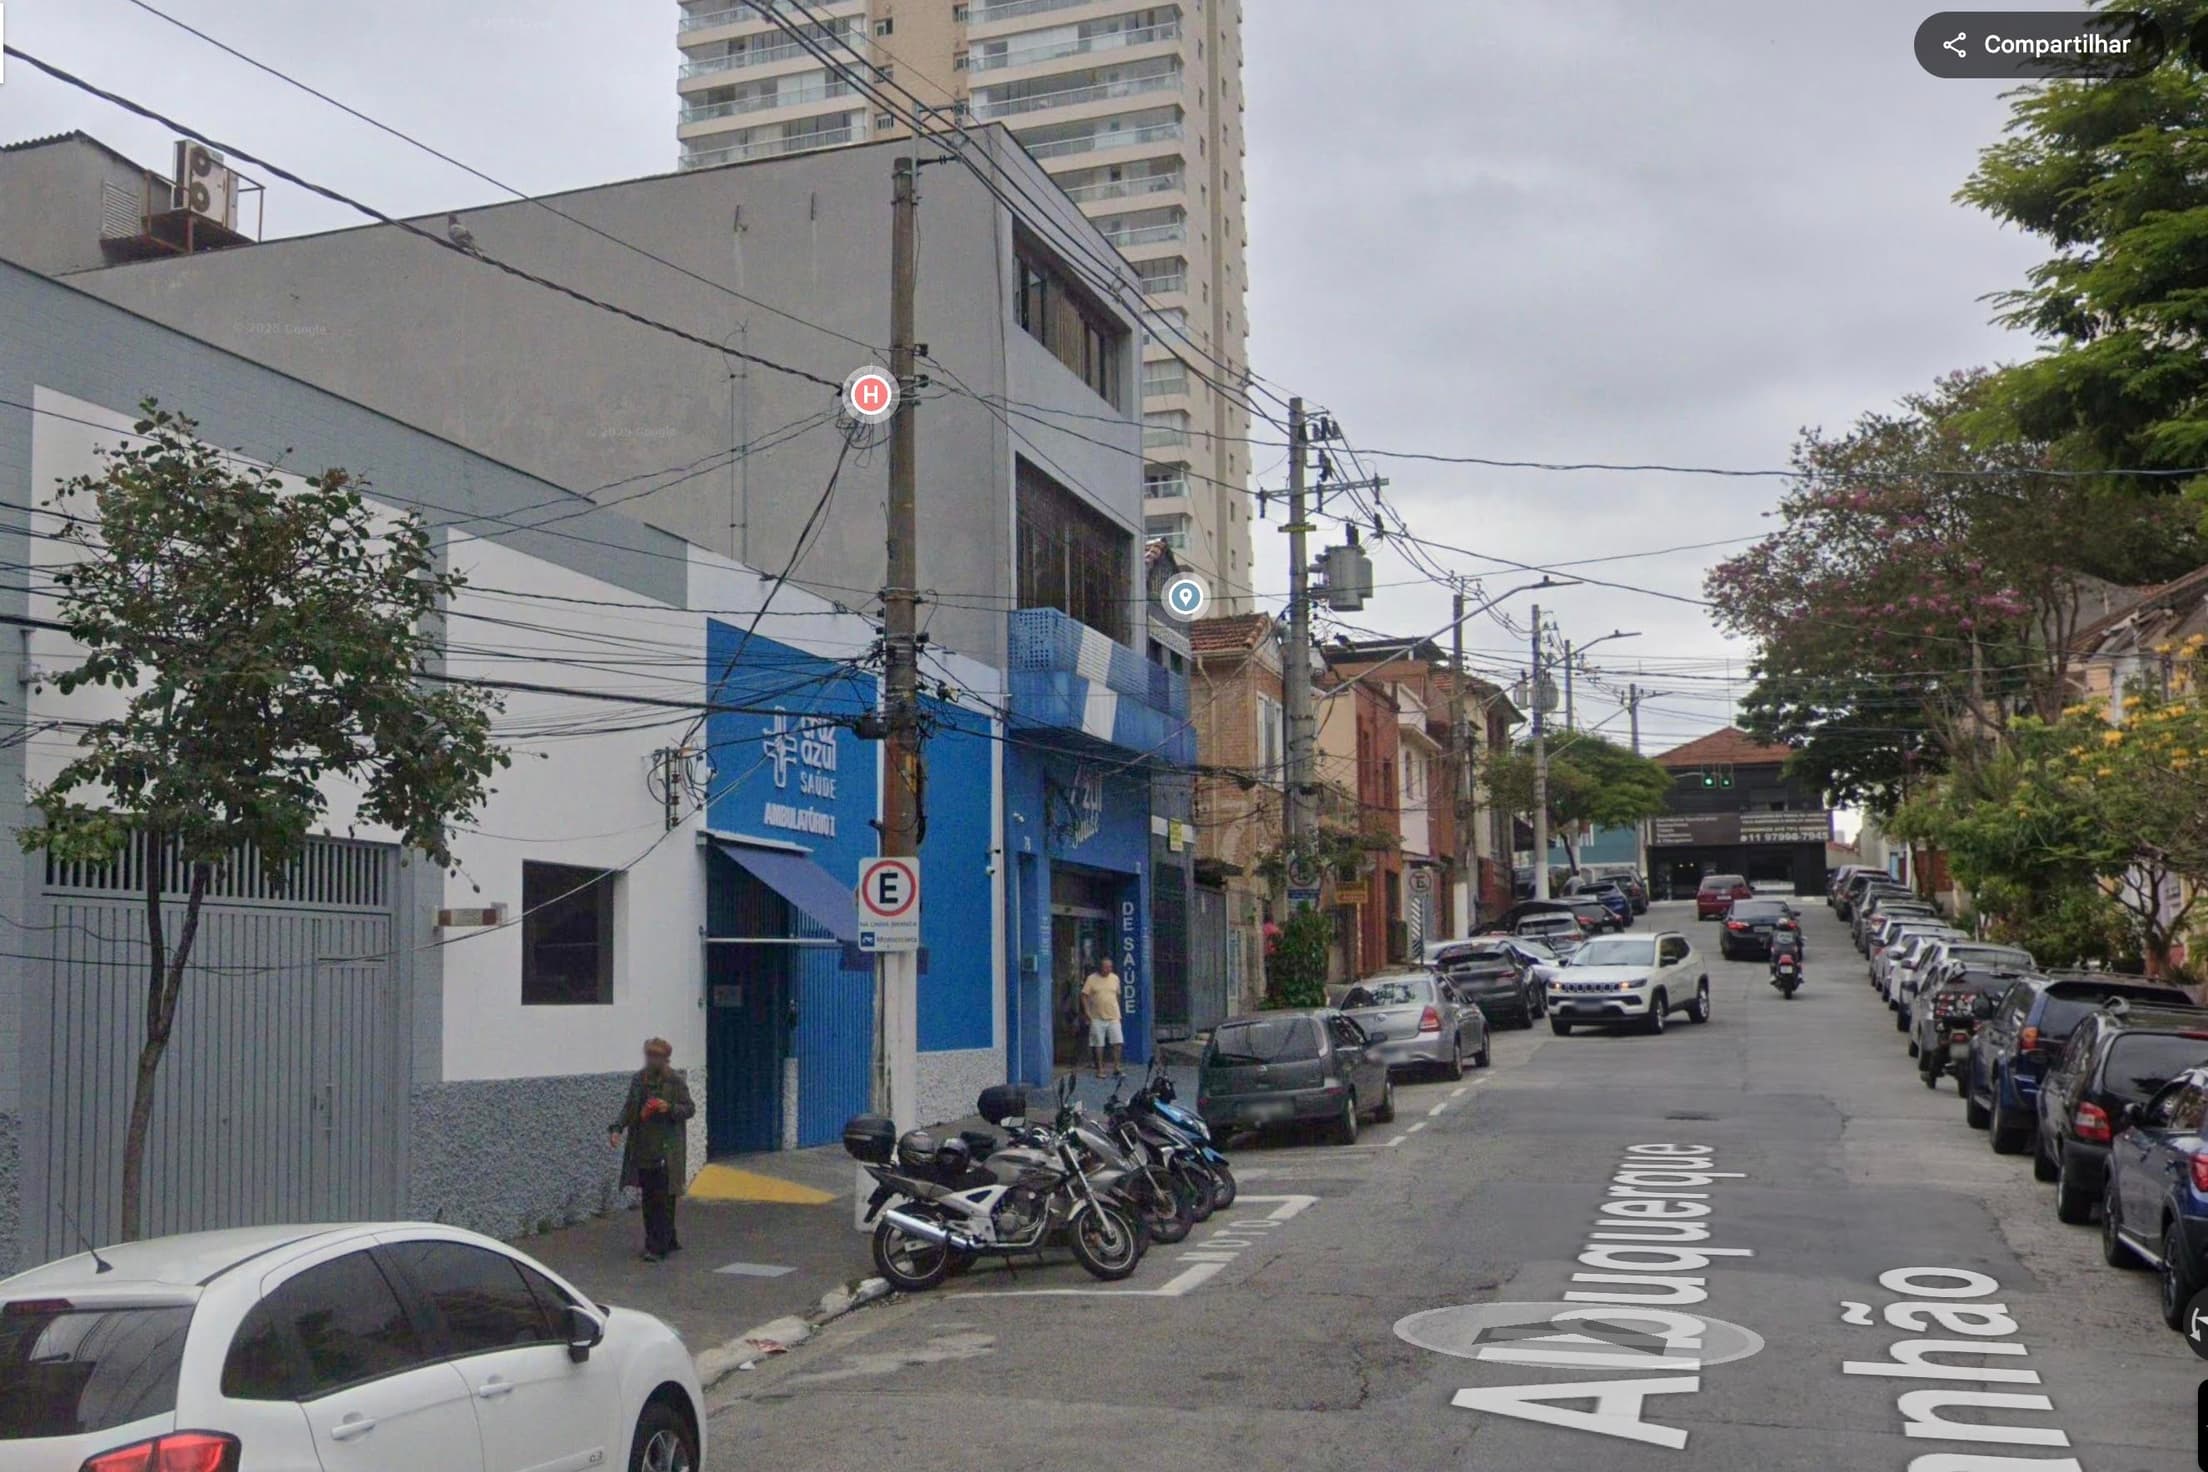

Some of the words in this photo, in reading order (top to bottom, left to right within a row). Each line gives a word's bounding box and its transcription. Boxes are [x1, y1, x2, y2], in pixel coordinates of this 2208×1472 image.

[801, 740, 837, 771] azul
[800, 769, 837, 800] SAÚDE
[879, 872, 899, 904] E
